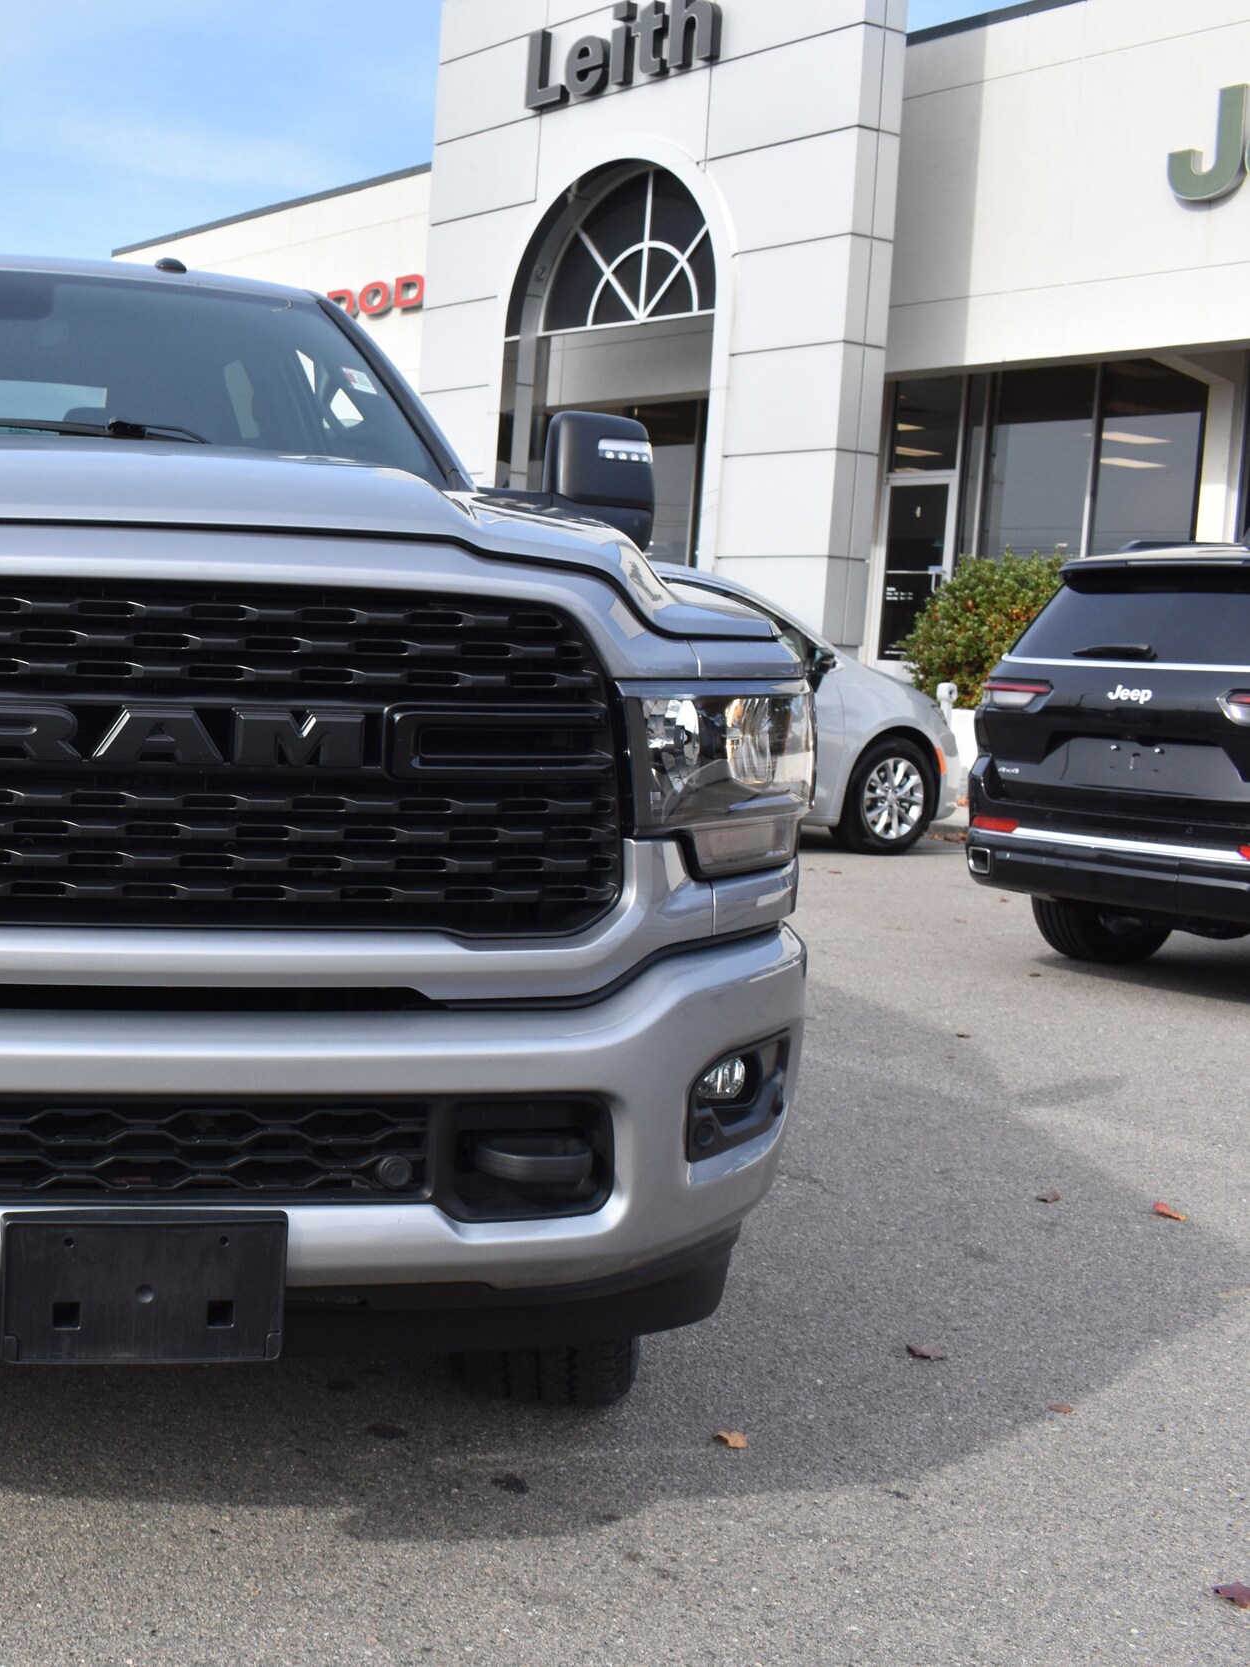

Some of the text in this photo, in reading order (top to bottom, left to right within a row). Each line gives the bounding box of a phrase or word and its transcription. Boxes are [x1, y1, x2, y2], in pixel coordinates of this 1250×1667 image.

[525, 0, 723, 109] Leith
[1167, 84, 1250, 201] J
[1107, 685, 1153, 704] Jeep
